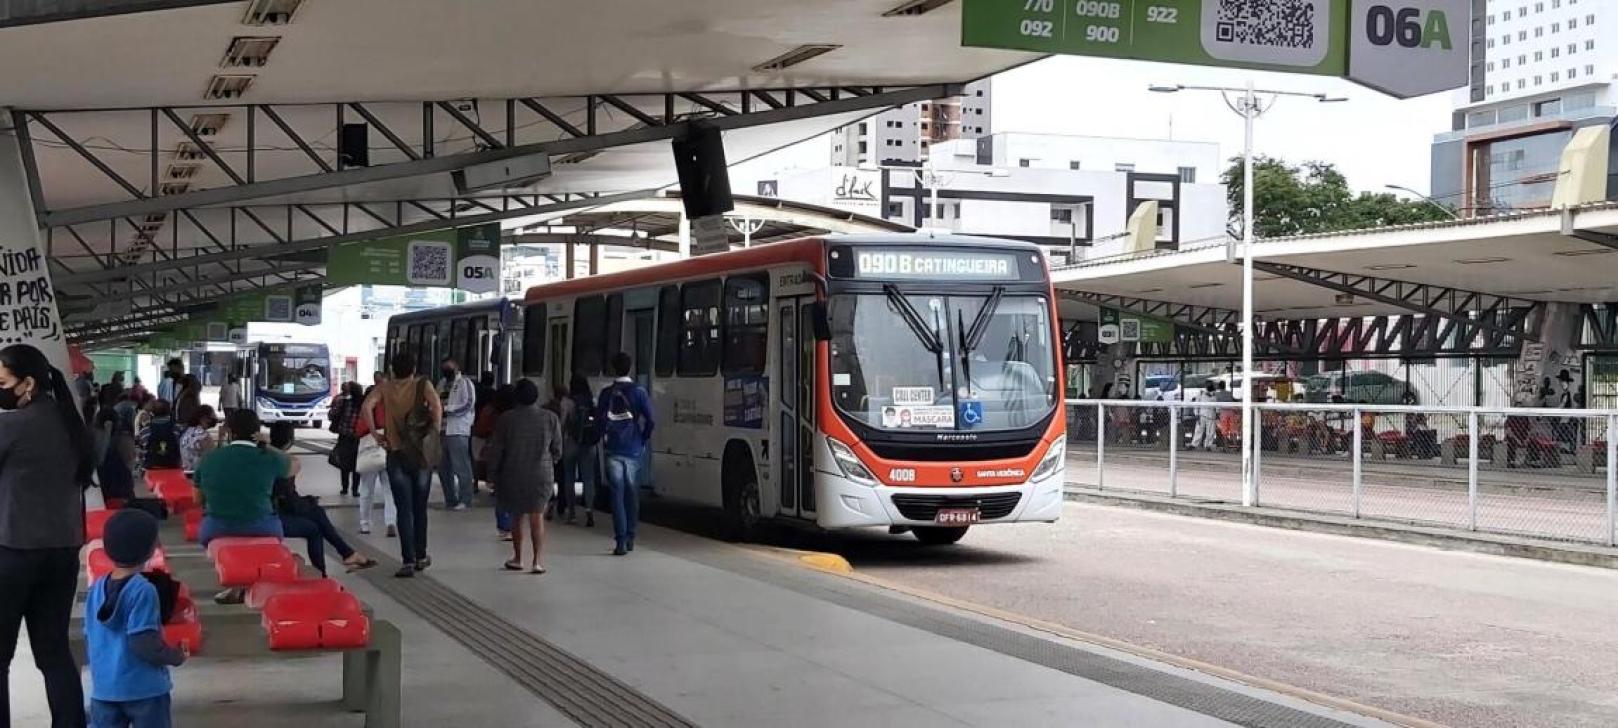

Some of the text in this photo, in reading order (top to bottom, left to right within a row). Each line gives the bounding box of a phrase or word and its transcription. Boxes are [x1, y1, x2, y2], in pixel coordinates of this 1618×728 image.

[1075, 0, 1120, 18] 090B
[1147, 6, 1178, 24] 922
[1020, 19, 1053, 38] 092
[1085, 25, 1120, 43] 900
[1366, 5, 1452, 50] 06A
[463, 266, 494, 280] 05A
[914, 256, 1007, 275] CATINGUEIRA
